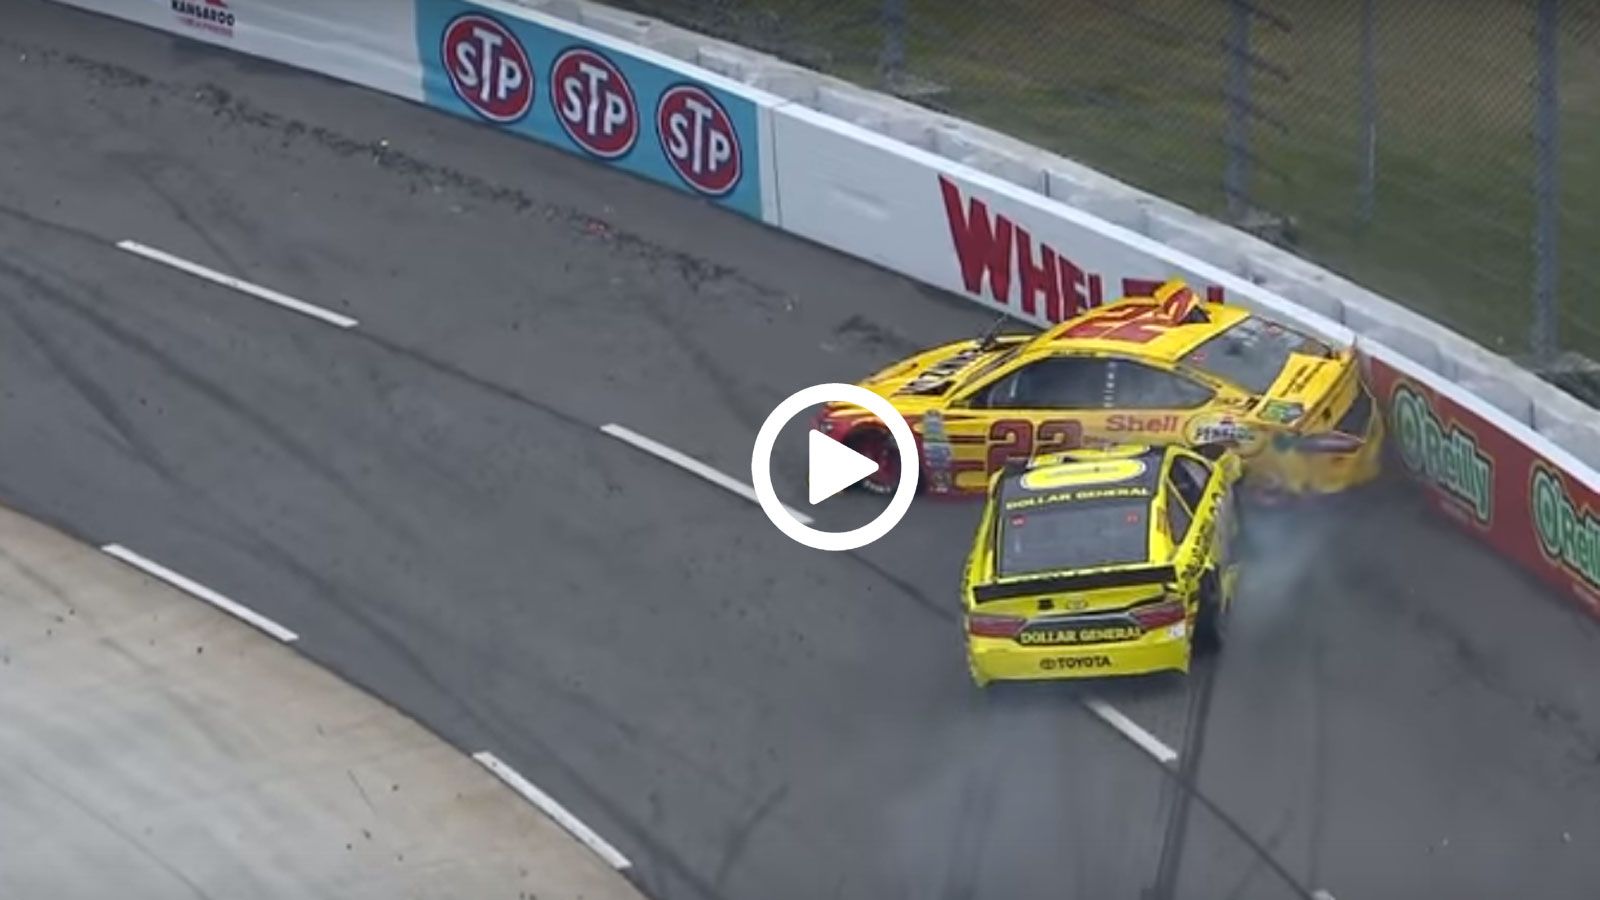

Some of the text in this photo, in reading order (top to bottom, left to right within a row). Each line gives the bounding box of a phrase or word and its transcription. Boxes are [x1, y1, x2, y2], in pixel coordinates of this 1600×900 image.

[171, 0, 236, 26] KANGAROO
[456, 27, 522, 101] STP
[563, 62, 627, 135] STP
[669, 99, 731, 173] STP
[1105, 414, 1178, 433] Shell
[1005, 487, 1150, 511] DOLLAR GENERAL
[1020, 627, 1142, 645] DOLLAR GENERAL
[1056, 655, 1112, 669] TOYOTA
